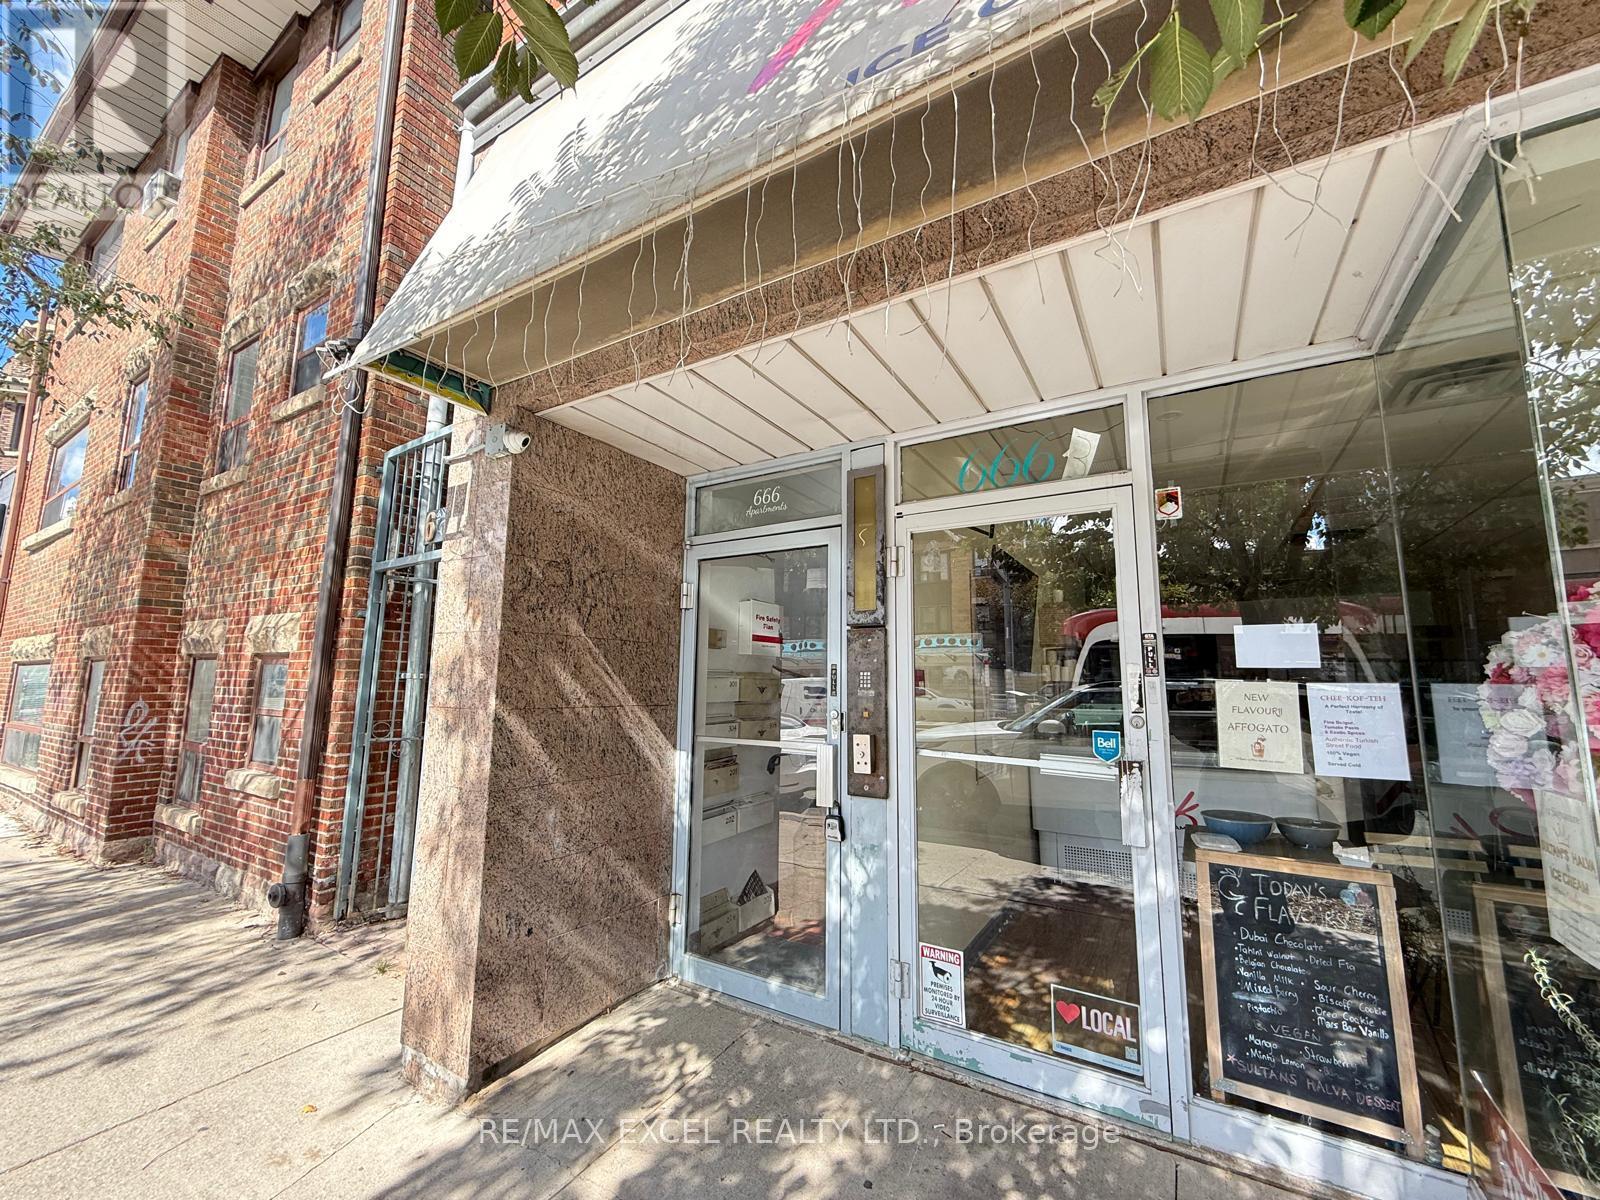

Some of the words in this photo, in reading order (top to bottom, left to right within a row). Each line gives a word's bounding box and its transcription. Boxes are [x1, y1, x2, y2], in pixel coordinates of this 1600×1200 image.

[957, 432, 1056, 494] 666
[752, 485, 781, 506] 666
[745, 502, 788, 517] Apartments
[766, 615, 780, 624] Safety
[1244, 693, 1269, 702] NEW
[1227, 722, 1289, 734] AFFOGATO
[1097, 737, 1116, 748] Bell
[1250, 872, 1327, 900] TODAY'S
[1240, 926, 1268, 943] Dubai
[1274, 933, 1324, 951] Chocolate
[922, 946, 960, 965] WARNING
[1237, 943, 1263, 956] Tahini
[1239, 954, 1266, 969] Belgian
[1309, 955, 1332, 966] Dried
[1239, 966, 1266, 980] Vanilla
[1273, 974, 1294, 985] Milk
[924, 987, 953, 999] MONITORED
[930, 981, 953, 992] PREMISES
[1244, 981, 1273, 994] Mixed
[1314, 980, 1336, 992] Sour
[1344, 985, 1378, 1003] Cherry
[935, 1003, 950, 1012] VIDEO
[938, 998, 953, 1006] HOUR
[1319, 994, 1352, 1011] Biscoff
[1359, 1002, 1387, 1016] Cookie
[925, 1008, 960, 1022] SURVEILLANCE
[1315, 1006, 1338, 1019] Oreo
[1343, 1012, 1375, 1027] Cookie
[1080, 1005, 1137, 1043] LOCAL
[1270, 1024, 1320, 1040] VEGAN
[1317, 1016, 1339, 1029] Mars
[1341, 1021, 1357, 1033] Bar
[1359, 1025, 1390, 1039] Vanilla
[1248, 1033, 1278, 1055] Mango
[1250, 1048, 1276, 1067] Minty
[1280, 1054, 1305, 1070] Lemon
[1303, 1046, 1357, 1073] Strawberry
[1307, 1079, 1351, 1102] HALVA
[1356, 1092, 1400, 1113] DESSERT
